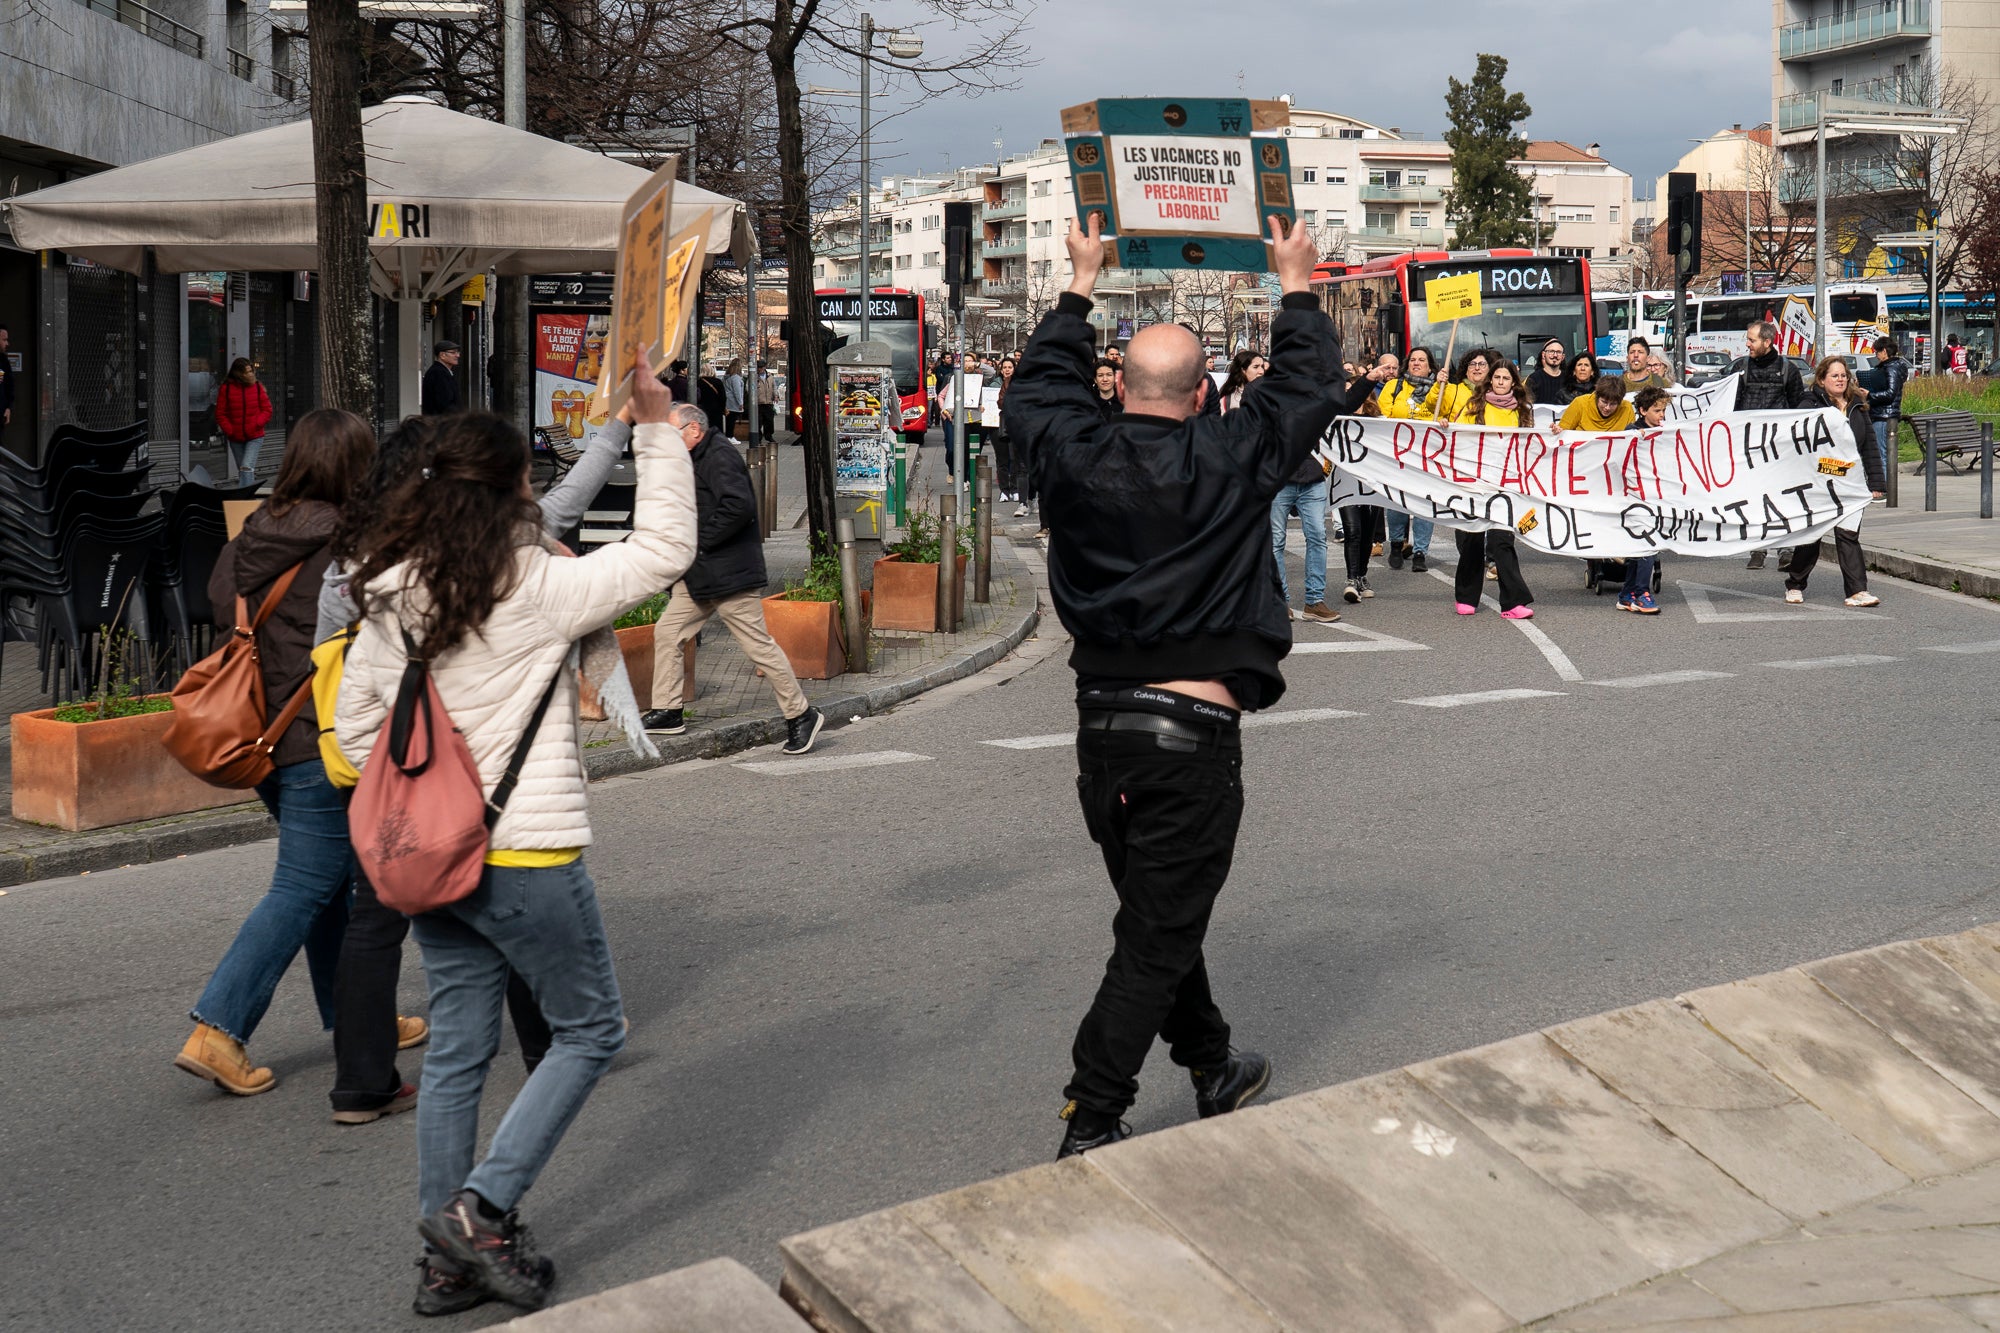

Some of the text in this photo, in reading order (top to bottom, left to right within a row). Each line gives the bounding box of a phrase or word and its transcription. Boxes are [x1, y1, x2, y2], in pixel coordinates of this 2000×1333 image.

[1123, 146, 1241, 167] LES VACANCES NO
[1133, 166, 1236, 186] JUSTIFIQUEN LA
[1144, 184, 1229, 203] PRECARIETAT
[367, 203, 430, 238] VARI
[1157, 203, 1220, 221] LABORAL!
[1128, 239, 1149, 251] A4
[1491, 267, 1554, 292] ROCA
[820, 300, 898, 316] CAN JORESA
[542, 325, 582, 337] SE TE HACE
[548, 334, 559, 343] LA
[560, 335, 579, 345] BOCA
[545, 351, 575, 362] WANTA?
[1675, 420, 1735, 496] NO
[1743, 421, 1778, 469] HI
[1791, 414, 1835, 455] HA
[1546, 503, 1594, 551] DE
[1133, 690, 1176, 705] Calvin Klein
[1193, 703, 1233, 722] Calvin Klein
